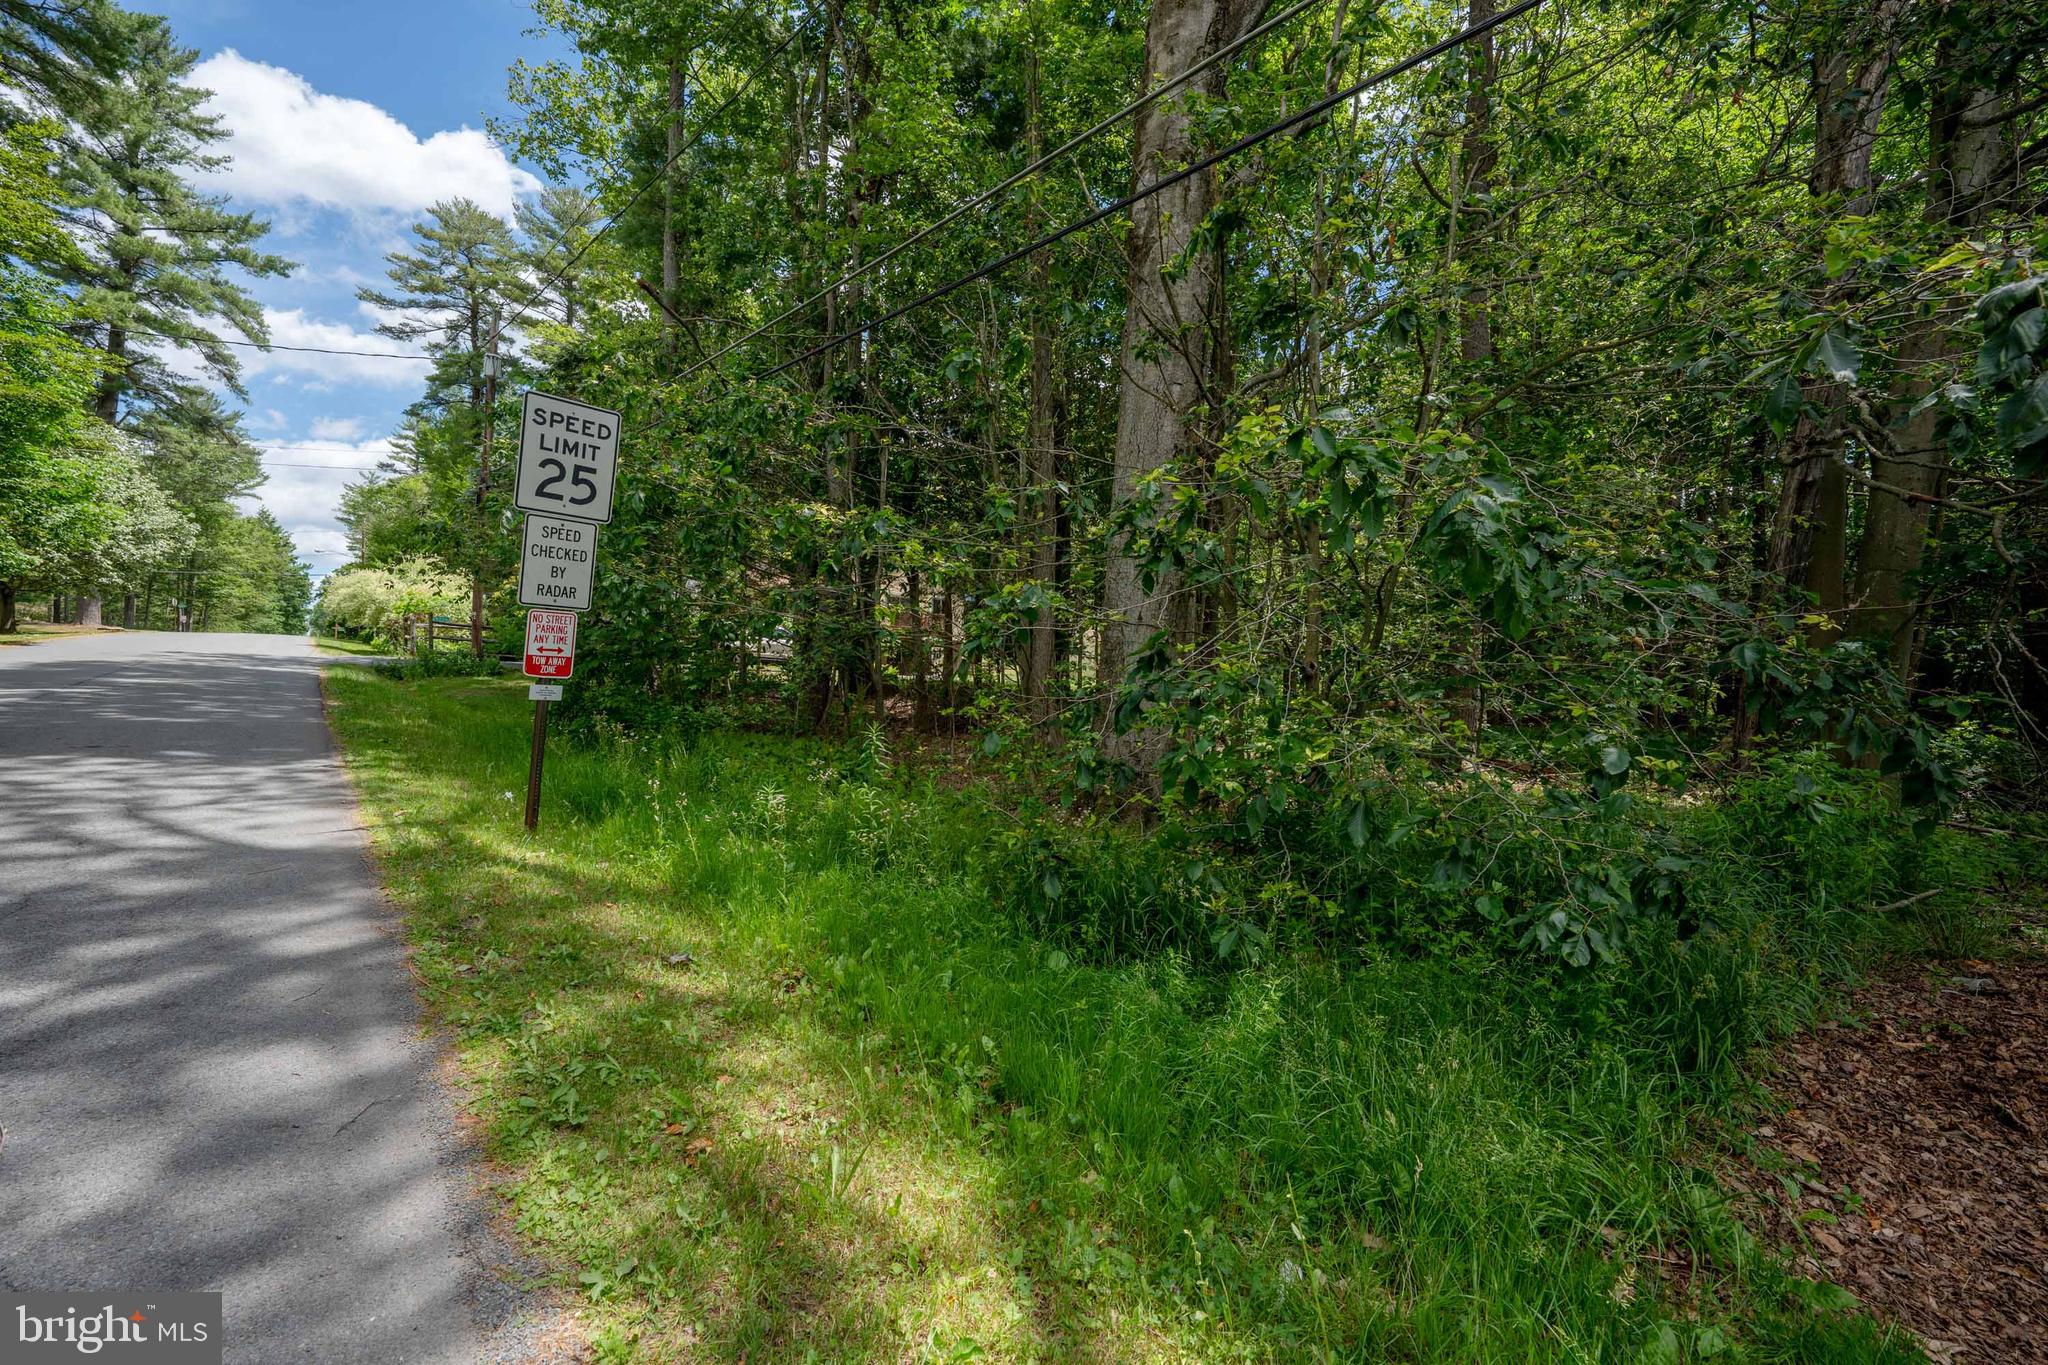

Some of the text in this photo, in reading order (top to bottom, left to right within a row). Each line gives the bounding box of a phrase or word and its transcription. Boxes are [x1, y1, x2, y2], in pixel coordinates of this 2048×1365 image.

[532, 408, 611, 440] SPEED
[540, 433, 600, 461] LIMIT
[535, 458, 597, 505] 25
[541, 525, 581, 542] SPEED
[531, 543, 587, 562] CHECKED
[551, 565, 566, 579] BY
[536, 583, 577, 599] RADAR
[532, 613, 573, 625] NO STREET
[535, 623, 568, 635] PARKING
[533, 634, 568, 645] ANY TIME
[532, 656, 566, 666] TOW AWAY
[540, 665, 557, 673] ZONE
